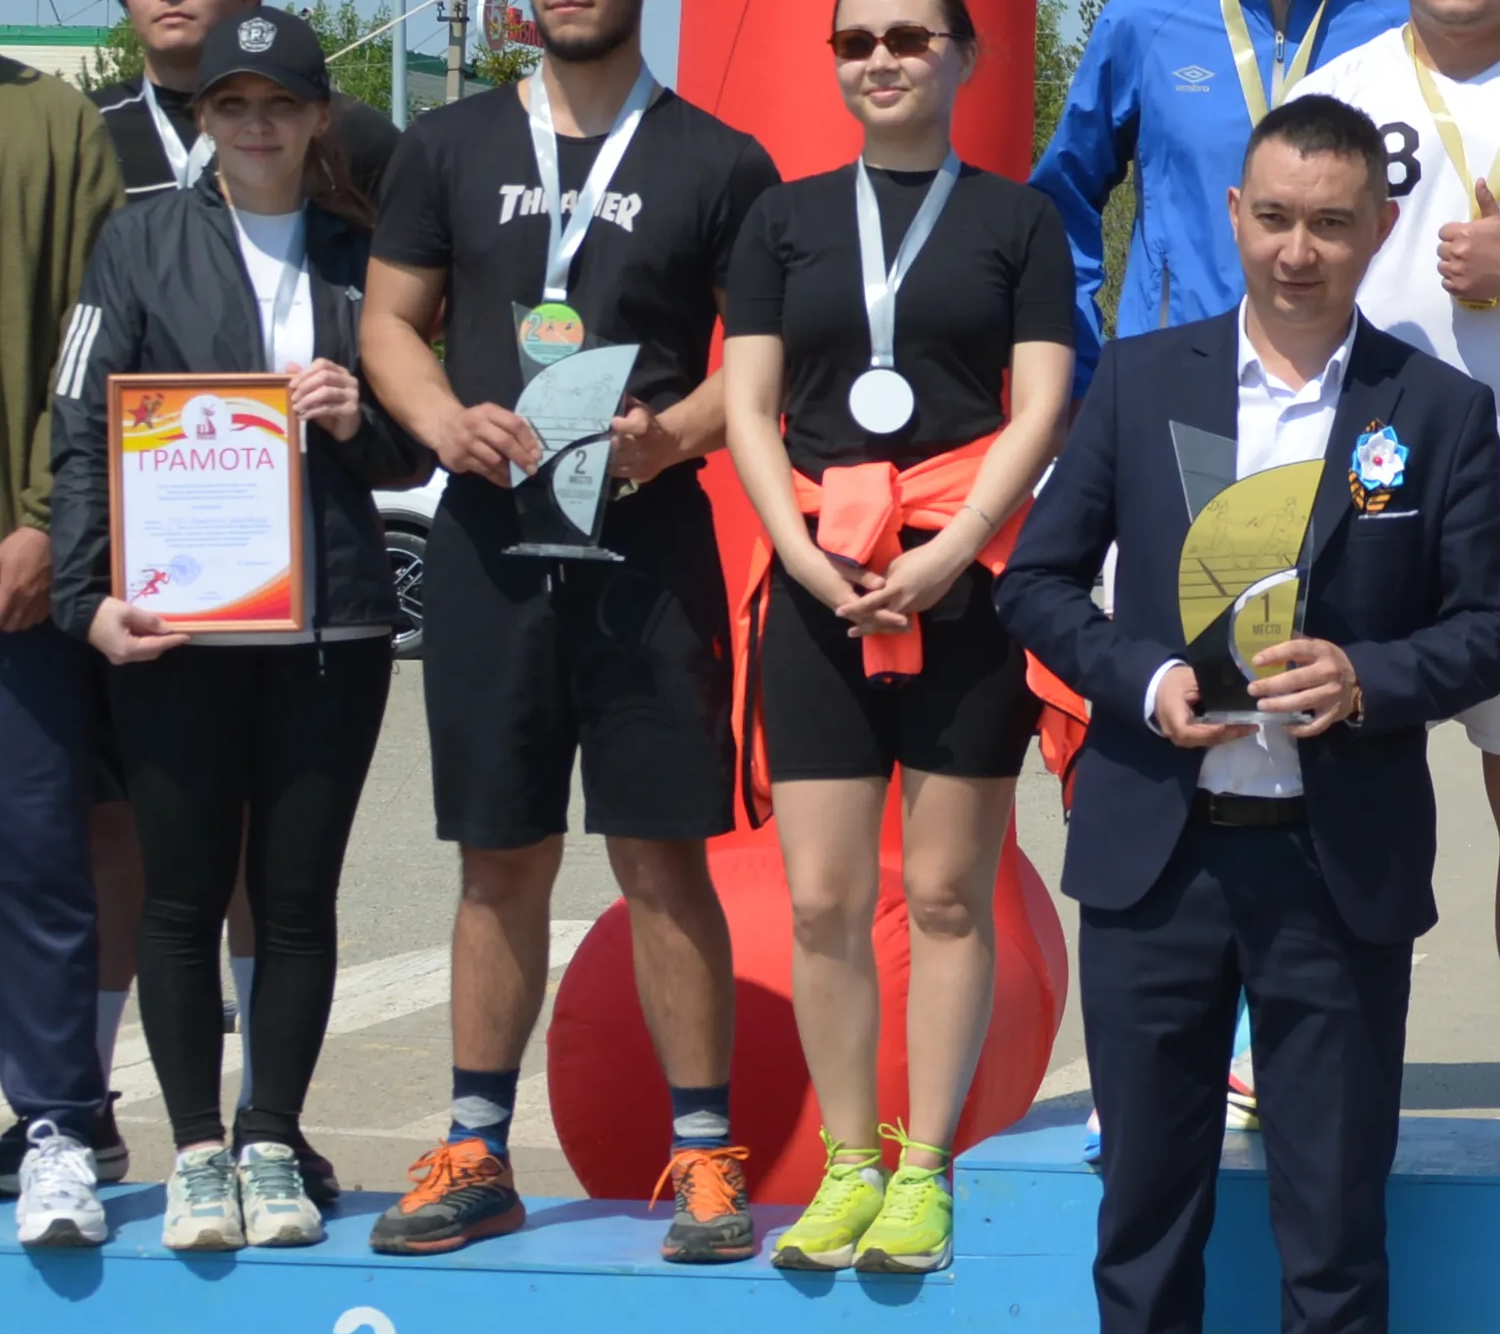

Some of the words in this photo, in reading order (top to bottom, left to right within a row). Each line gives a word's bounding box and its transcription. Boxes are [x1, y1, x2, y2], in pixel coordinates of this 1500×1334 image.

[525, 313, 542, 342] 2
[138, 447, 276, 472] ГРАМОТА
[574, 449, 588, 475] 2
[1260, 592, 1270, 623] 1
